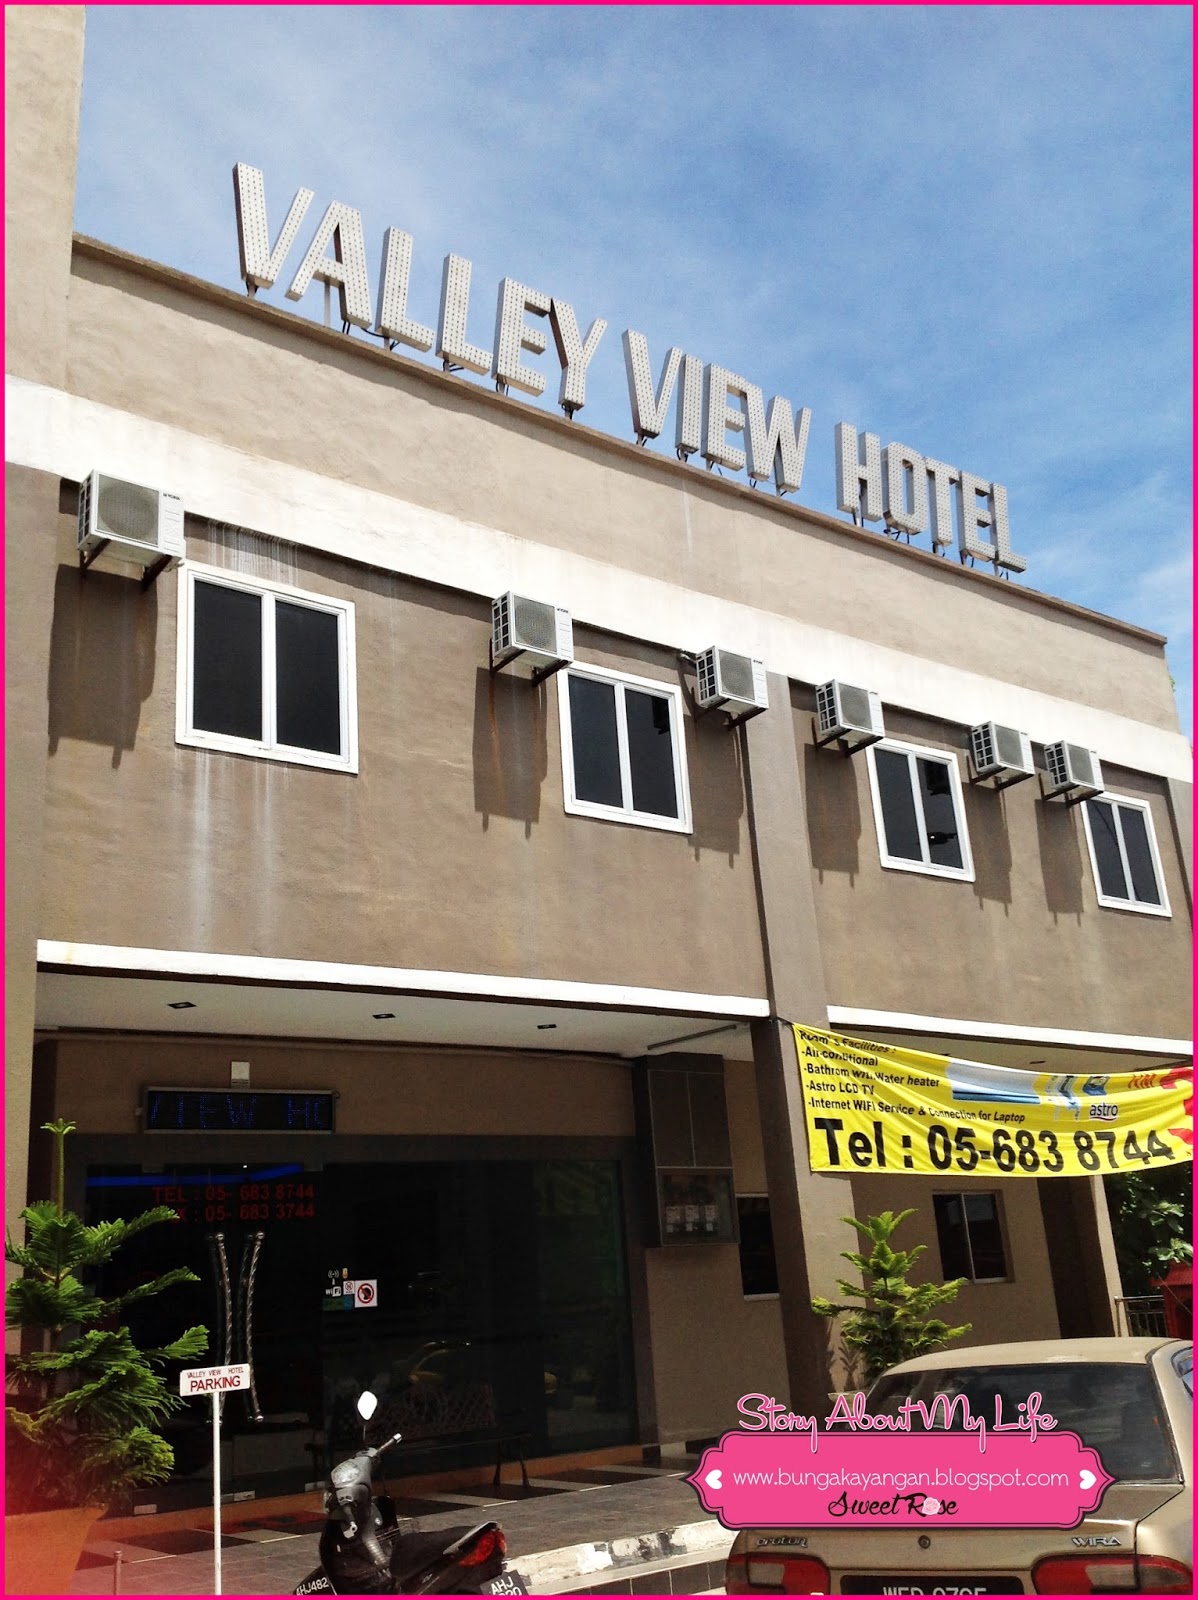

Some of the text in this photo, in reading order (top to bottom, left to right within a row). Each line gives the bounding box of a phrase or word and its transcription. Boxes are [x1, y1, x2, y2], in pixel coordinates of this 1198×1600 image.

[232, 162, 1027, 573] VALLEY VIEW HOTEL
[842, 1038, 889, 1053] Facilities
[839, 1082, 858, 1094] LCD
[861, 1084, 875, 1096] TV
[876, 1073, 904, 1084] Water
[907, 1075, 940, 1088] heater
[878, 1101, 914, 1115] Service
[918, 1106, 926, 1116] &
[929, 1107, 976, 1120] Connection
[978, 1109, 992, 1121] for
[993, 1111, 1026, 1124] Laptop
[1089, 1102, 1119, 1117] astro
[814, 1117, 887, 1168] Tel
[928, 1125, 1064, 1173] 05-683
[1073, 1130, 1176, 1171] 8744
[153, 1187, 187, 1203] TEL
[239, 1184, 270, 1200] 683
[275, 1184, 316, 1199] 8744
[239, 1203, 270, 1220] 683
[275, 1203, 316, 1219] 3744
[187, 1370, 206, 1378] VALLEY
[190, 1375, 240, 1392] PARKING
[1072, 1536, 1122, 1547] WIRA
[491, 1575, 514, 1596] AHJ
